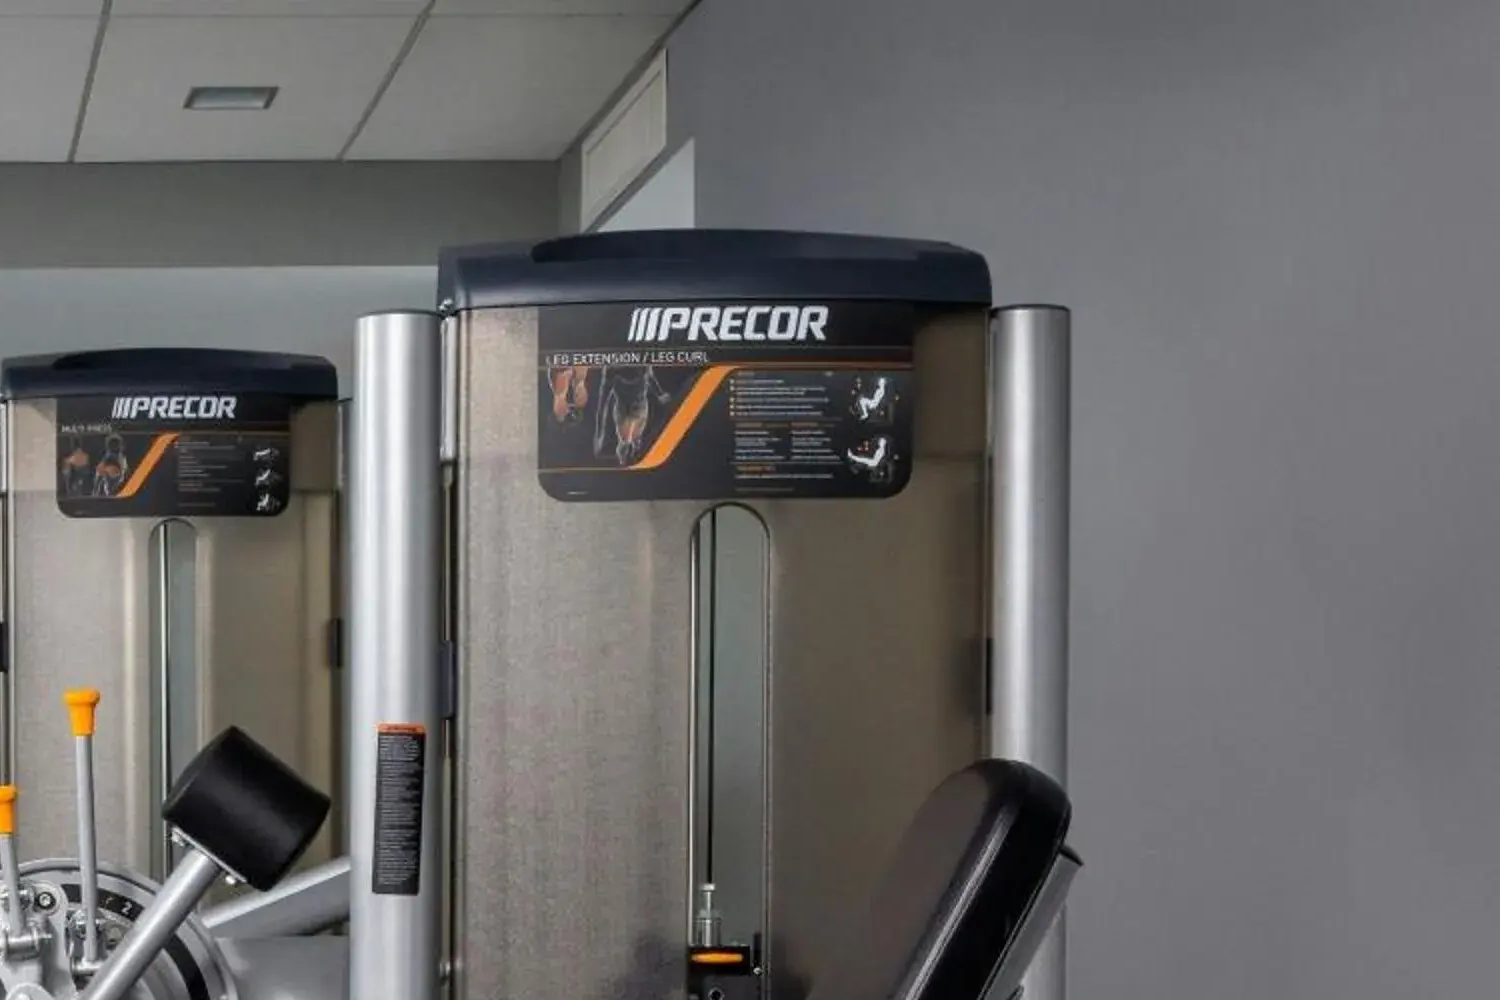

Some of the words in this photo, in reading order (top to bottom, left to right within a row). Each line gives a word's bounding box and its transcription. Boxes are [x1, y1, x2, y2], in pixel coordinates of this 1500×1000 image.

[657, 305, 829, 341] PRECOR
[573, 353, 641, 365] EXTENSION
[651, 352, 674, 363] LEG
[677, 351, 708, 363] CURL
[129, 396, 237, 419] PRECOR
